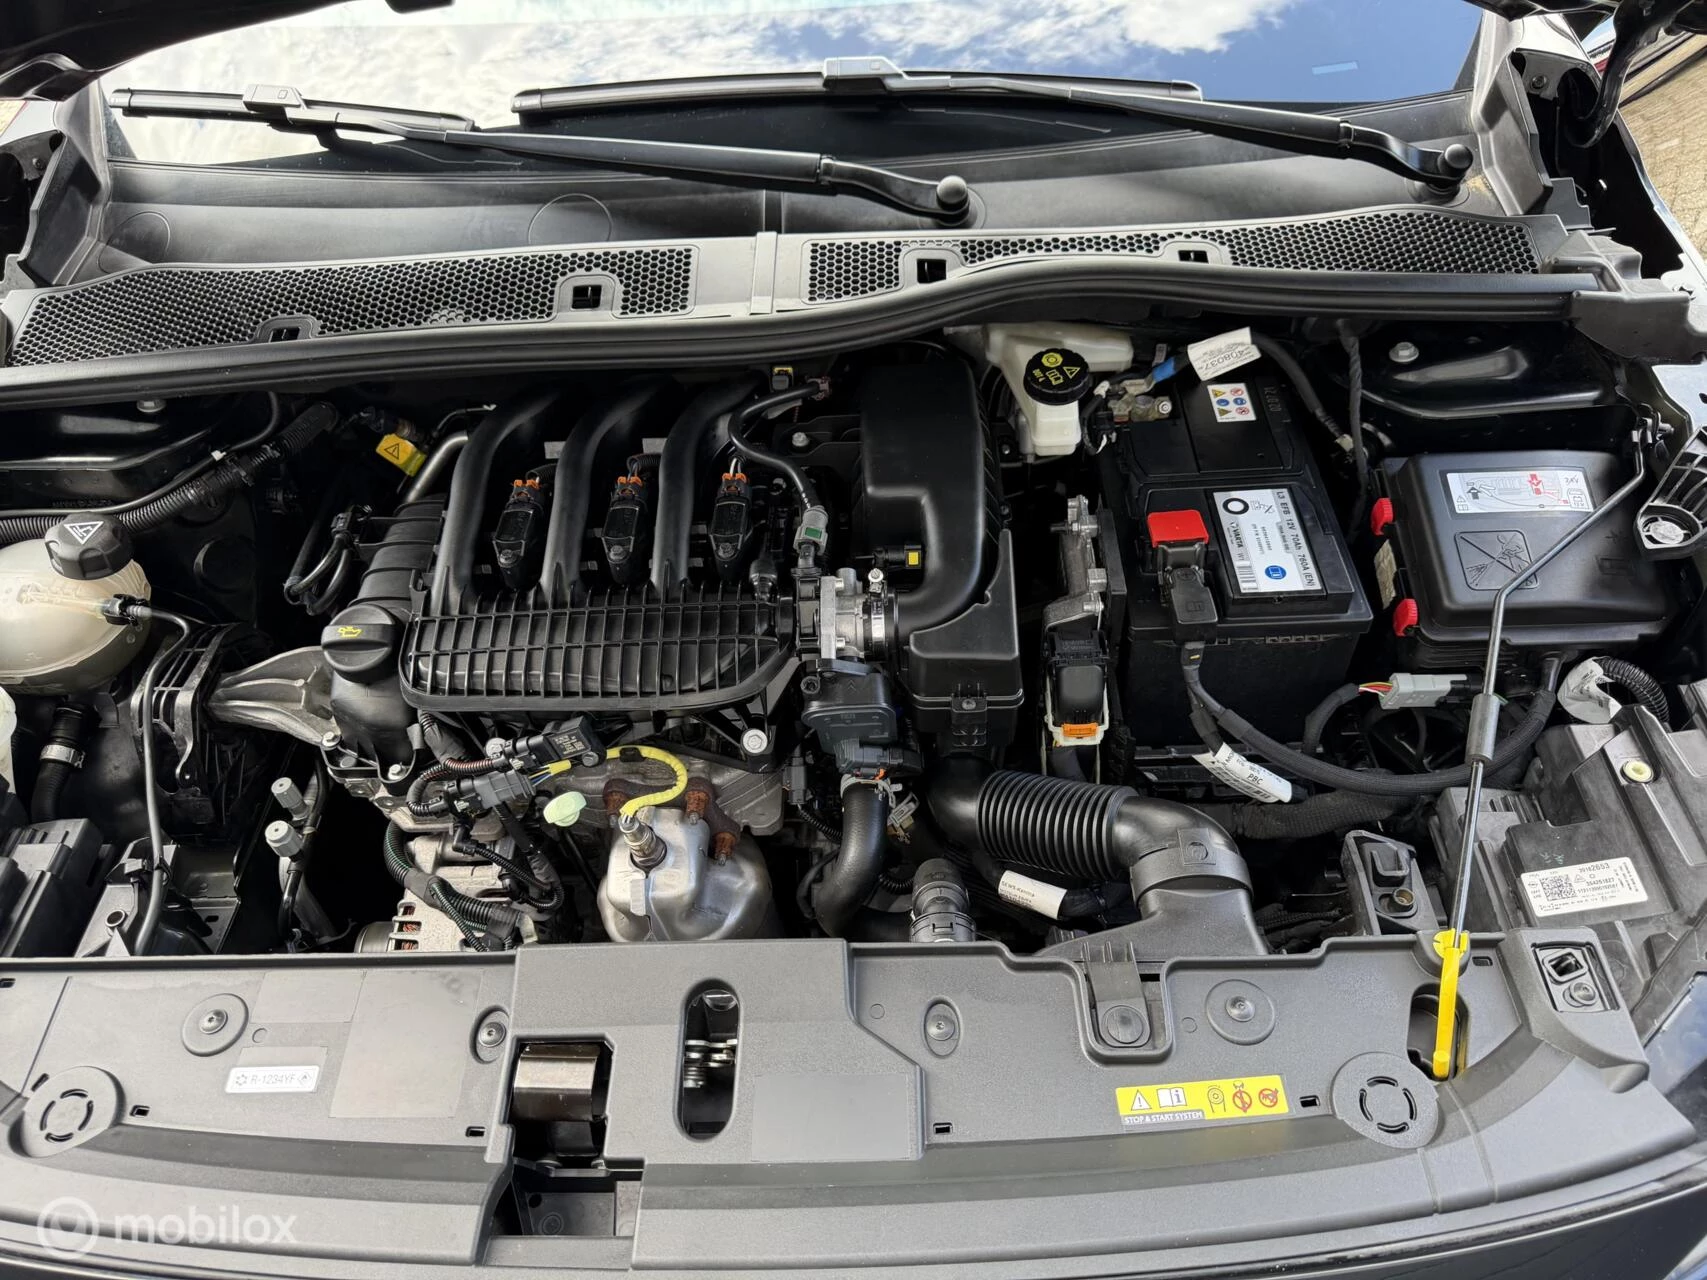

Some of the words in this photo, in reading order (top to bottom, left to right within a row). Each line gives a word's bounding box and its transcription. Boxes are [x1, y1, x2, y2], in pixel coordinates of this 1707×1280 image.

[1276, 491, 1284, 500] L3
[1280, 503, 1290, 515] EFB
[1286, 518, 1296, 530] 12V
[1291, 533, 1302, 551] 70Ah
[1298, 554, 1310, 571] 760A
[1124, 1115, 1144, 1124] STOP
[1152, 1113, 1174, 1122] START
[1175, 1111, 1202, 1120] SYSTEM
